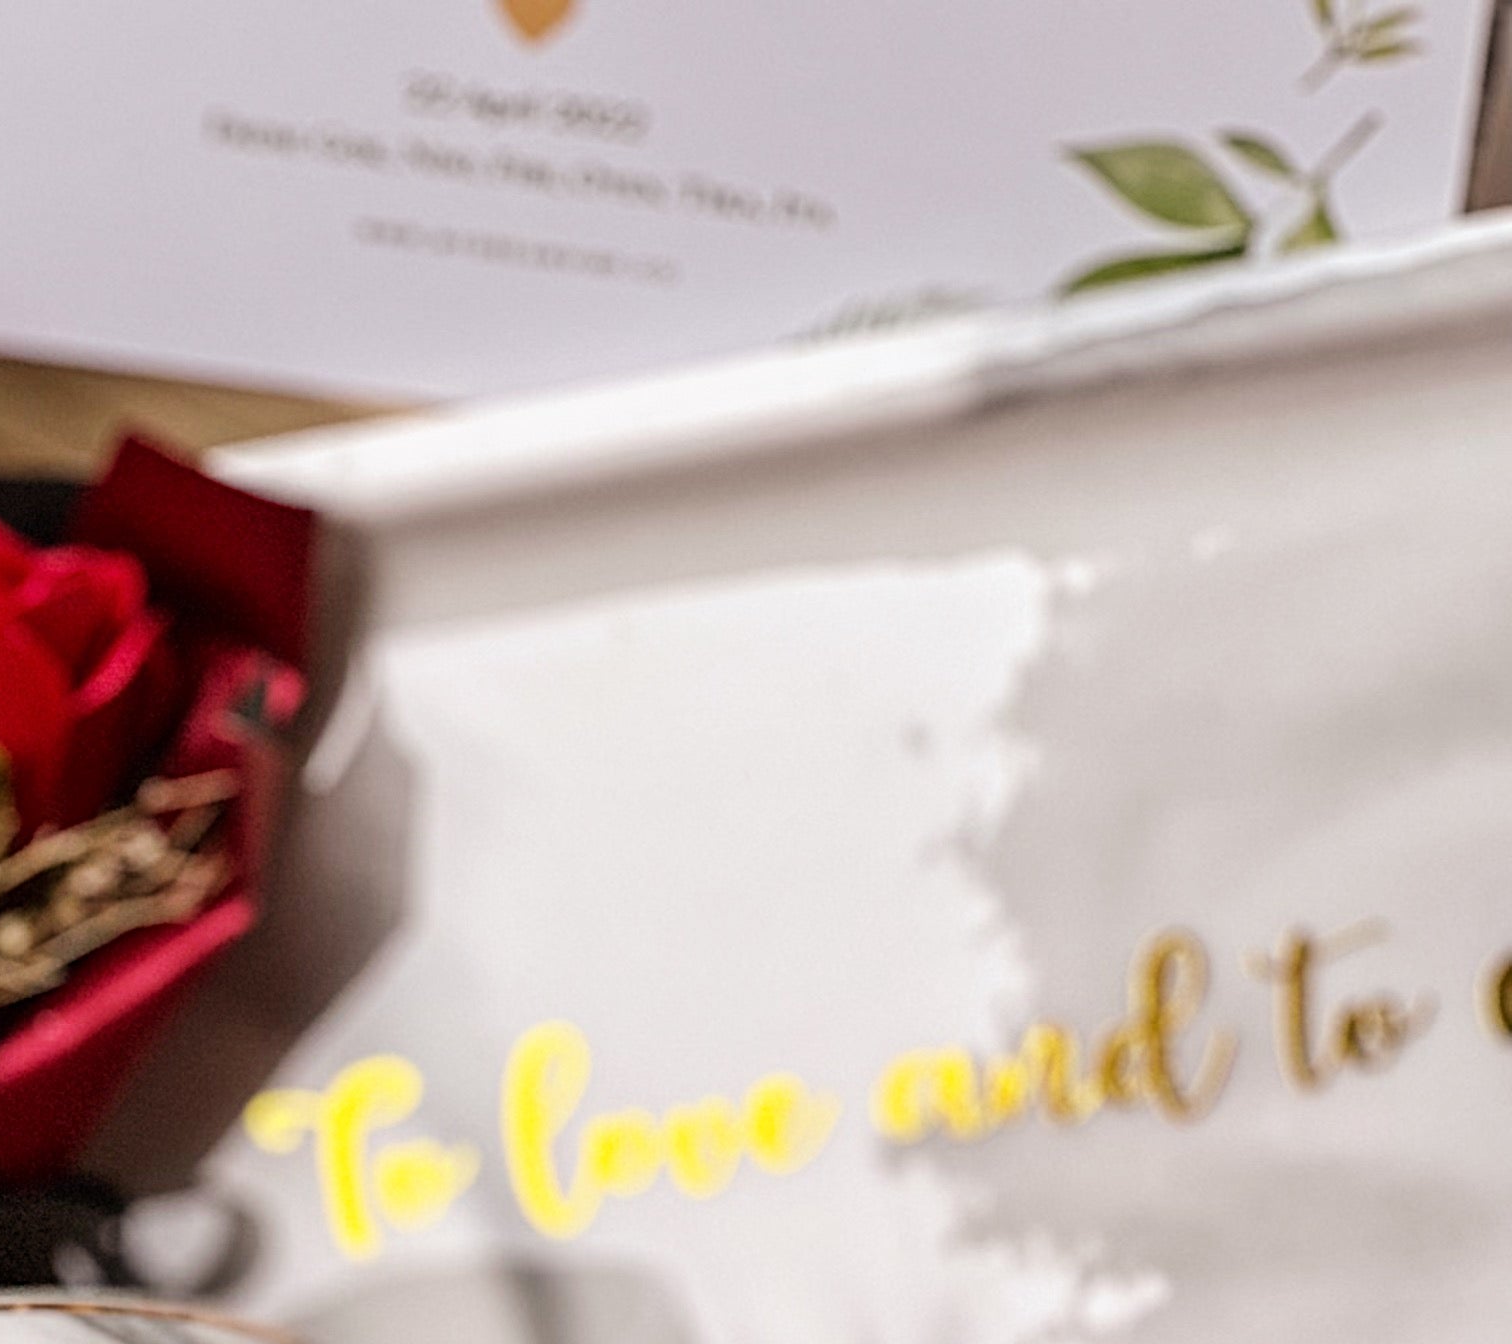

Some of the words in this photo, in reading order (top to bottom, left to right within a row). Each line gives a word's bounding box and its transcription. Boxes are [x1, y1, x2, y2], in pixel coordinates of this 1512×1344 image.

[240, 1055, 476, 1257] To
[503, 1020, 838, 1238] love
[873, 926, 1236, 1138] and
[1242, 918, 1436, 1092] to
